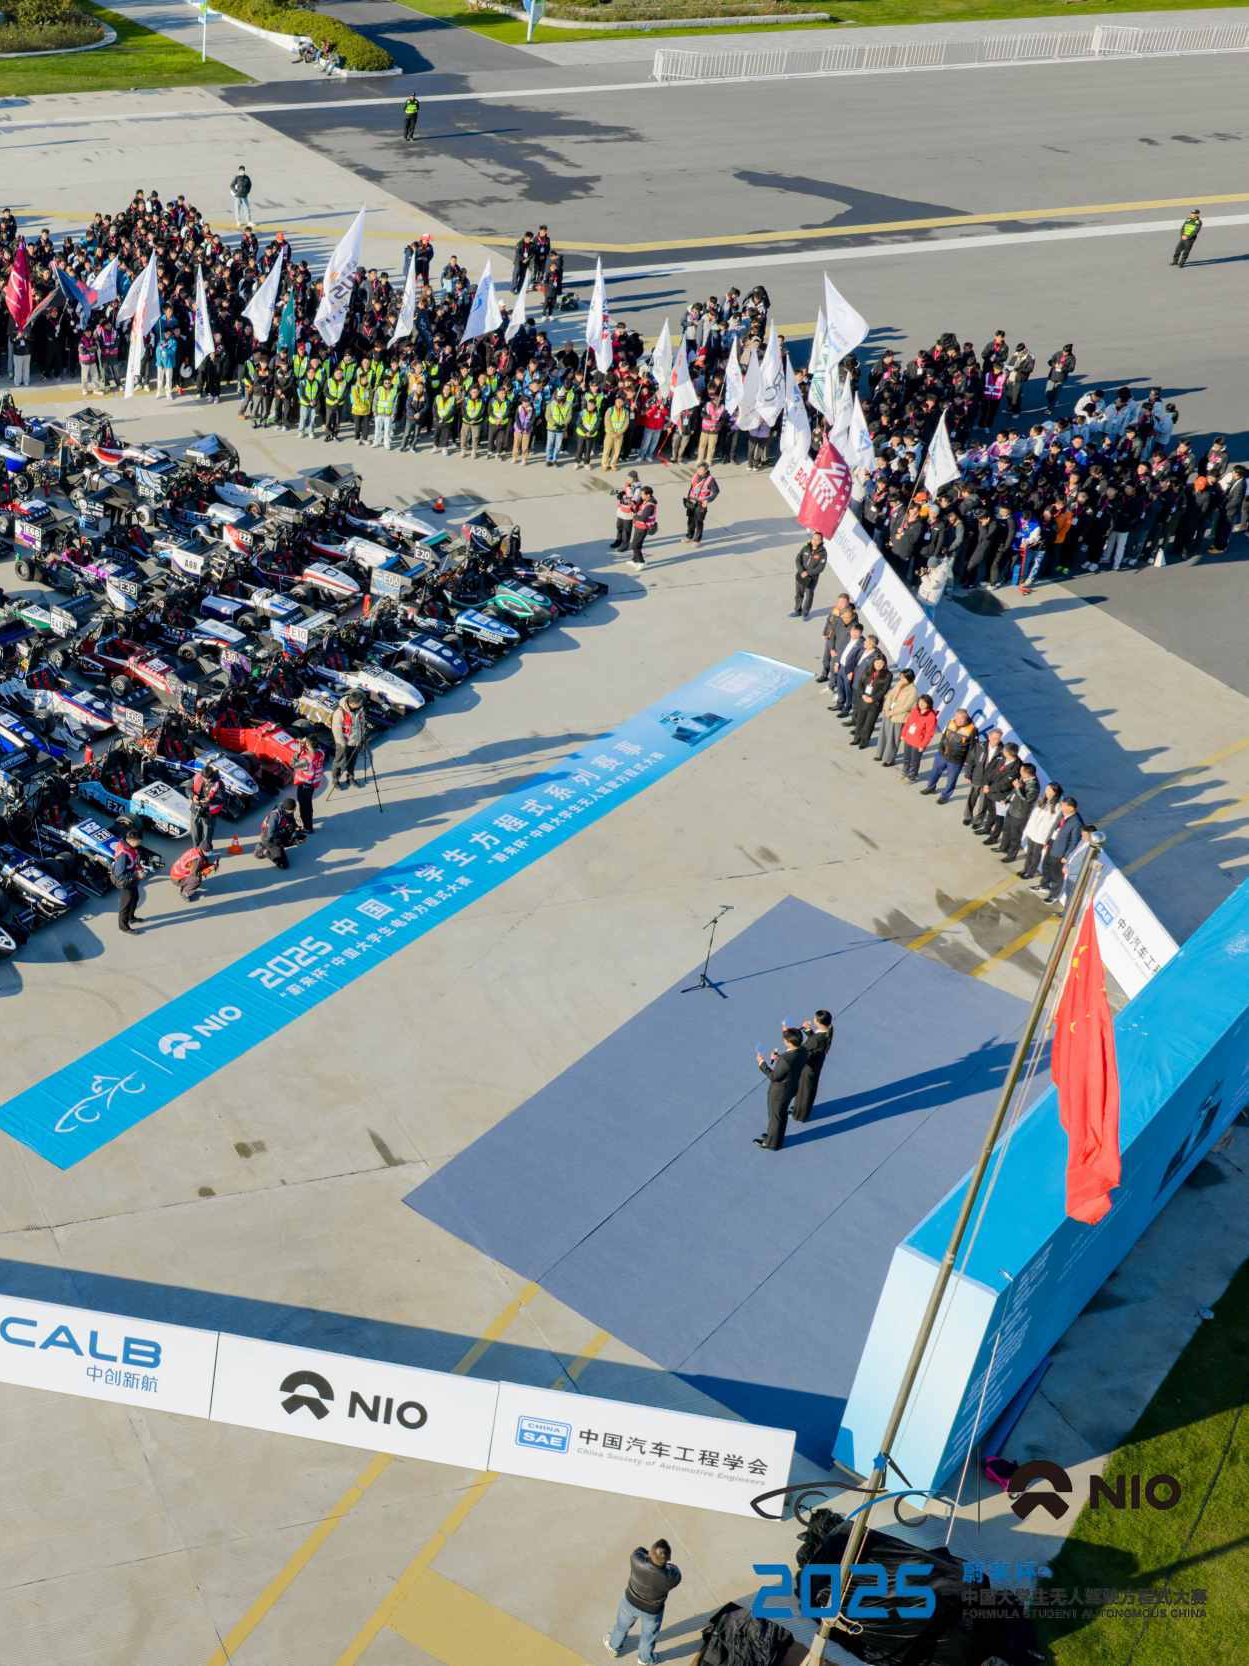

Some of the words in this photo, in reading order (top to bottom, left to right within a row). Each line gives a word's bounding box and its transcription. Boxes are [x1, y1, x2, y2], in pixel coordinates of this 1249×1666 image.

[470, 527, 487, 539] A29
[415, 549, 430, 560] E20
[121, 582, 136, 594] E39
[914, 646, 956, 706] AUMOVIO
[107, 801, 124, 813] E26
[247, 935, 335, 990] 2025
[192, 1005, 244, 1038] NIO
[86, 1364, 159, 1394] 中创新航
[347, 1390, 429, 1431] NIO
[523, 1431, 564, 1448] SAE
[527, 1421, 561, 1434] CHINA
[576, 1446, 605, 1459] China
[659, 1461, 715, 1479] Automotive
[716, 1470, 766, 1486] Engineers
[578, 1428, 769, 1476] 中国汽车工程学会
